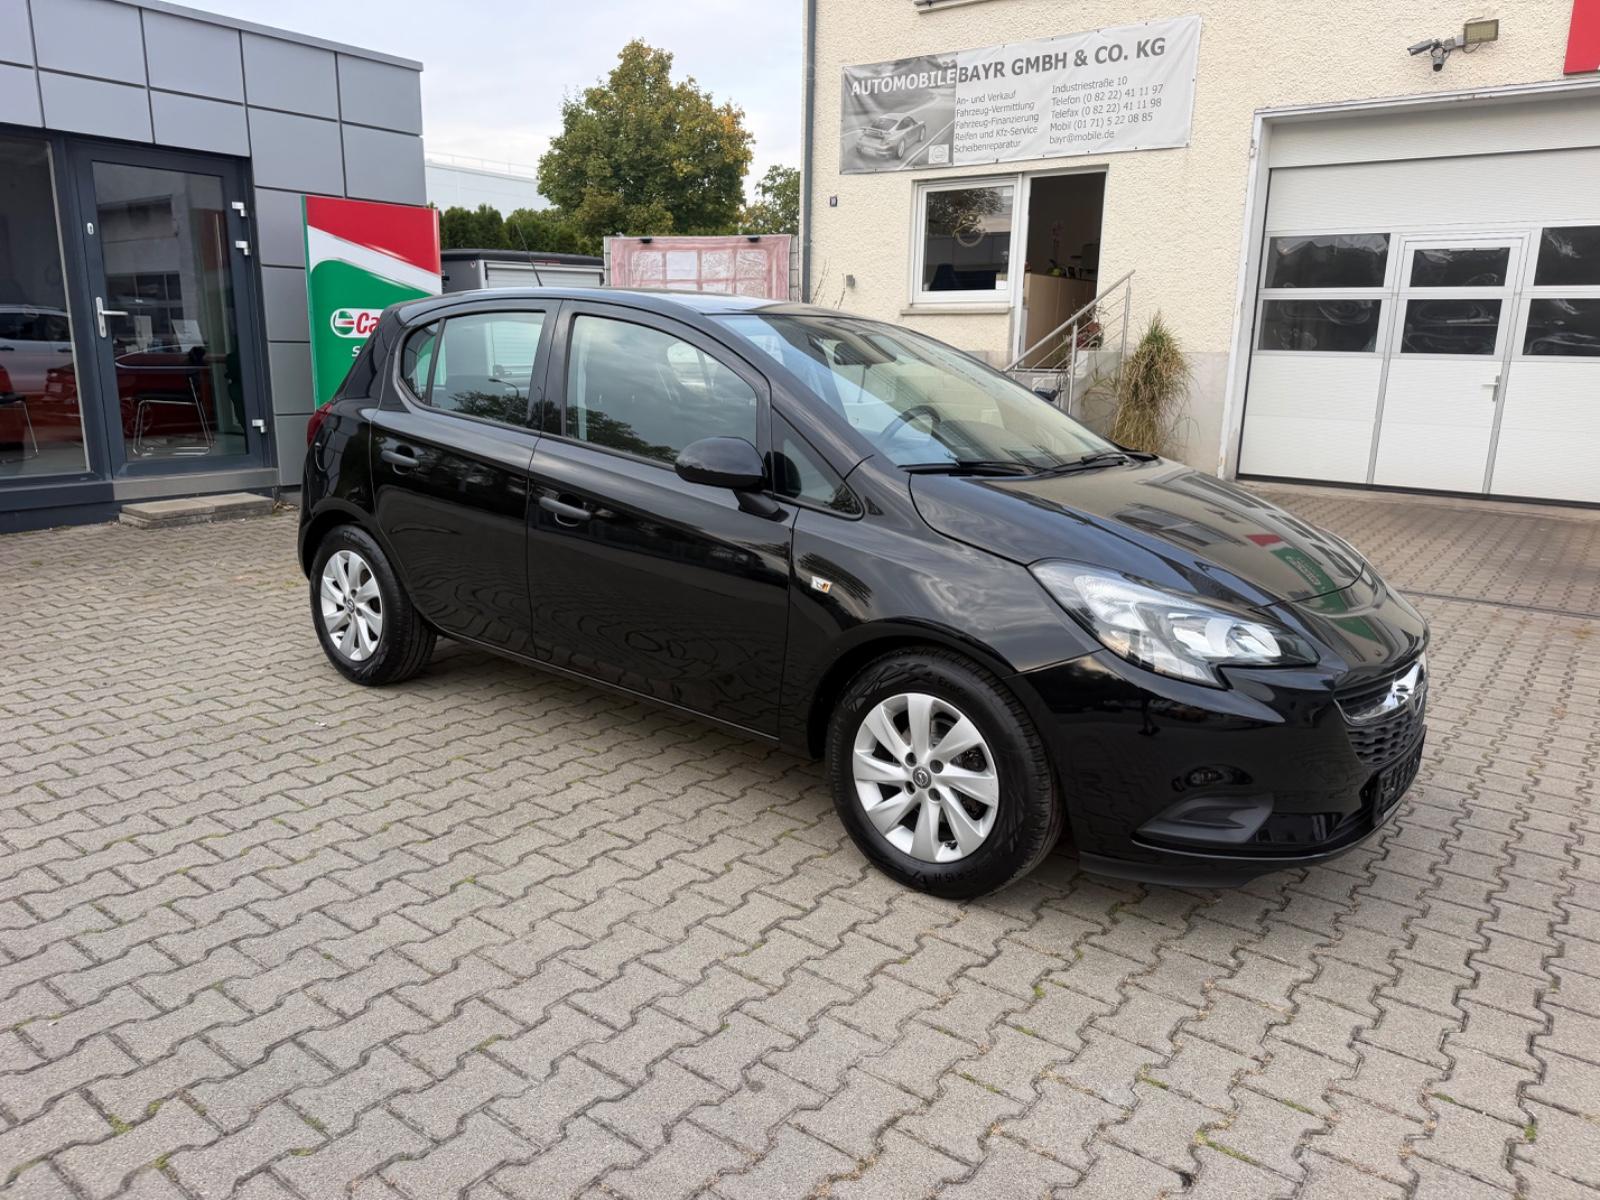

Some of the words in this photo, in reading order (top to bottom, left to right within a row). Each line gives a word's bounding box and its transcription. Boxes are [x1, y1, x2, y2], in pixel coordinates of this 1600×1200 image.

[851, 68, 957, 96] AUTOMOBILE
[958, 61, 1006, 83] BAYR
[1011, 52, 1067, 76] GMBH
[1074, 49, 1088, 67] &
[1094, 43, 1128, 65] CO.
[1136, 37, 1166, 59] KG
[1051, 77, 1114, 94] Industriestraße
[1117, 75, 1128, 86] 10
[970, 93, 986, 104] und
[987, 89, 1017, 102] Verkauf
[1051, 94, 1081, 106] Telefon
[1050, 107, 1079, 120] Telefax
[1049, 121, 1071, 132] Mobil
[955, 129, 978, 142] Reifen
[979, 129, 994, 140] und
[1049, 129, 1115, 145] bayr@mobile.de
[954, 139, 1022, 154] Scheibenreparatur
